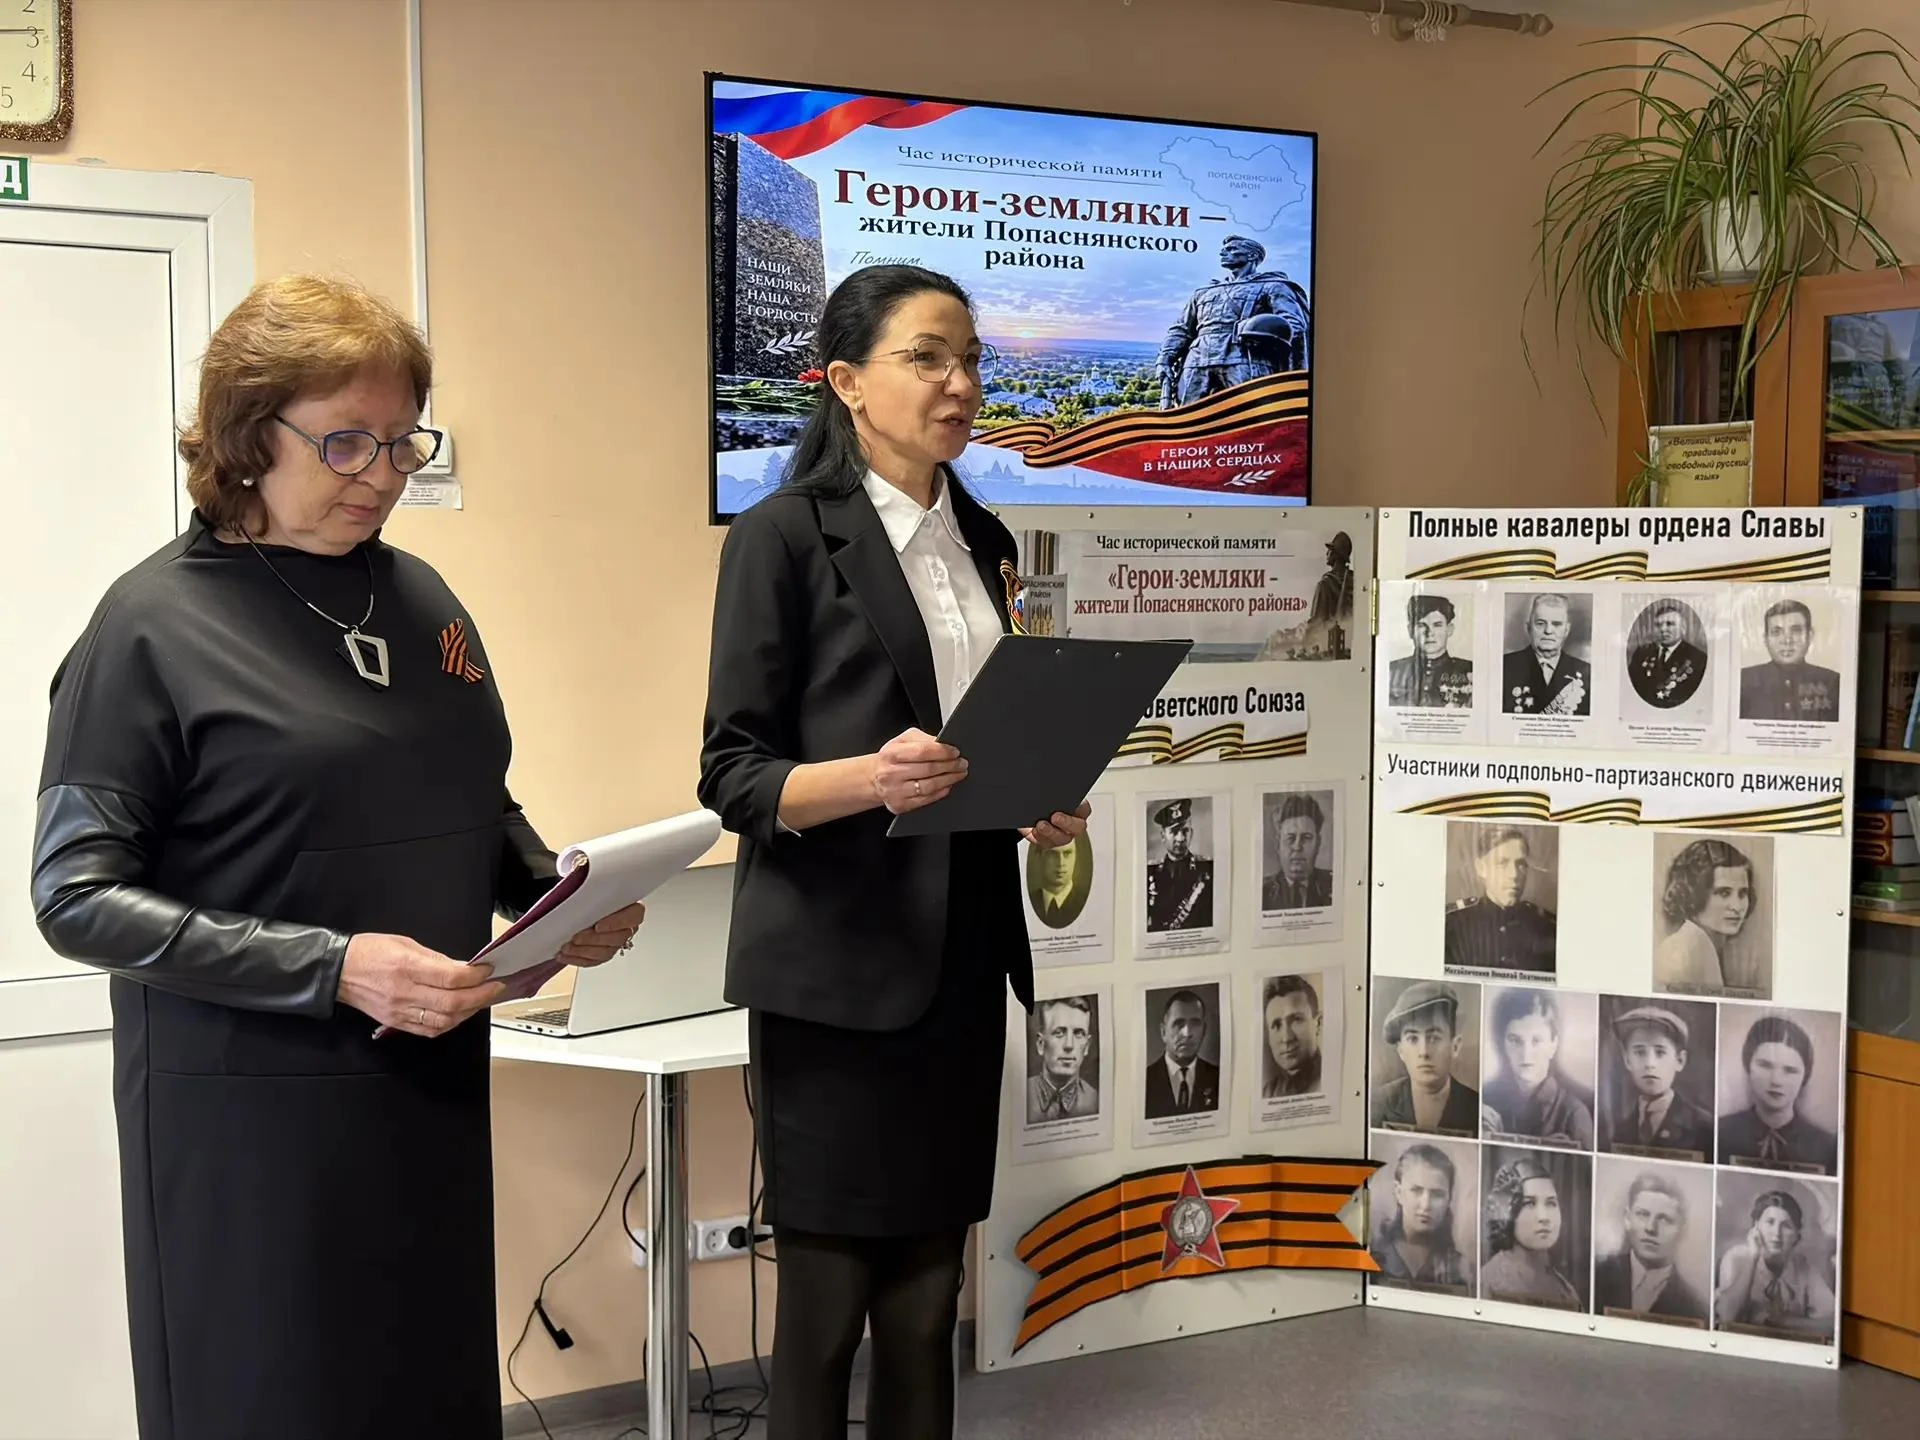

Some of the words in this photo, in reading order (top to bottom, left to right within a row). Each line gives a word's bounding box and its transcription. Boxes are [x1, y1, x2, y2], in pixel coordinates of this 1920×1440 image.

[26, 26, 39, 48] 3
[22, 60, 36, 82] 4
[1, 86, 13, 109] 5
[897, 145, 933, 160] Час
[941, 152, 1084, 172] исторической
[1092, 164, 1162, 179] памяти
[1229, 180, 1261, 190] РАЙОН
[834, 168, 1191, 228] Герои-земляки
[858, 216, 974, 239] жители
[983, 219, 1198, 253] Попаснянского
[747, 257, 791, 275] НАШИ
[984, 247, 1084, 270] района
[747, 273, 811, 293] ЗЕМЛЯКИ
[747, 289, 791, 305] НАША
[747, 305, 818, 324] ГОРДОСТЬ
[1160, 446, 1209, 458] ГЕРОИ
[1214, 443, 1265, 455] ЖИВУТ
[1143, 462, 1153, 472] В
[1157, 458, 1212, 471] НАШИХ
[1216, 454, 1282, 468] СЕРДЦАХ
[1409, 511, 1498, 538] Полные
[1507, 517, 1629, 545] кавалеры
[1639, 517, 1730, 545] ордена
[1741, 509, 1825, 538] Славы
[1096, 535, 1121, 549] Час
[1123, 535, 1219, 552] исторической
[1223, 538, 1277, 549] памяти
[1021, 580, 1065, 589] ОПАСНЯНСКИЙ
[1074, 599, 1129, 614] жители
[1133, 595, 1245, 613] Попаснянского
[1247, 593, 1308, 616] района»
[1144, 695, 1238, 719] оветского
[1245, 687, 1305, 714] Союза
[1387, 753, 1480, 779] Участники
[1486, 763, 1735, 790] подпольно-партизанского
[1740, 772, 1843, 793] движения
